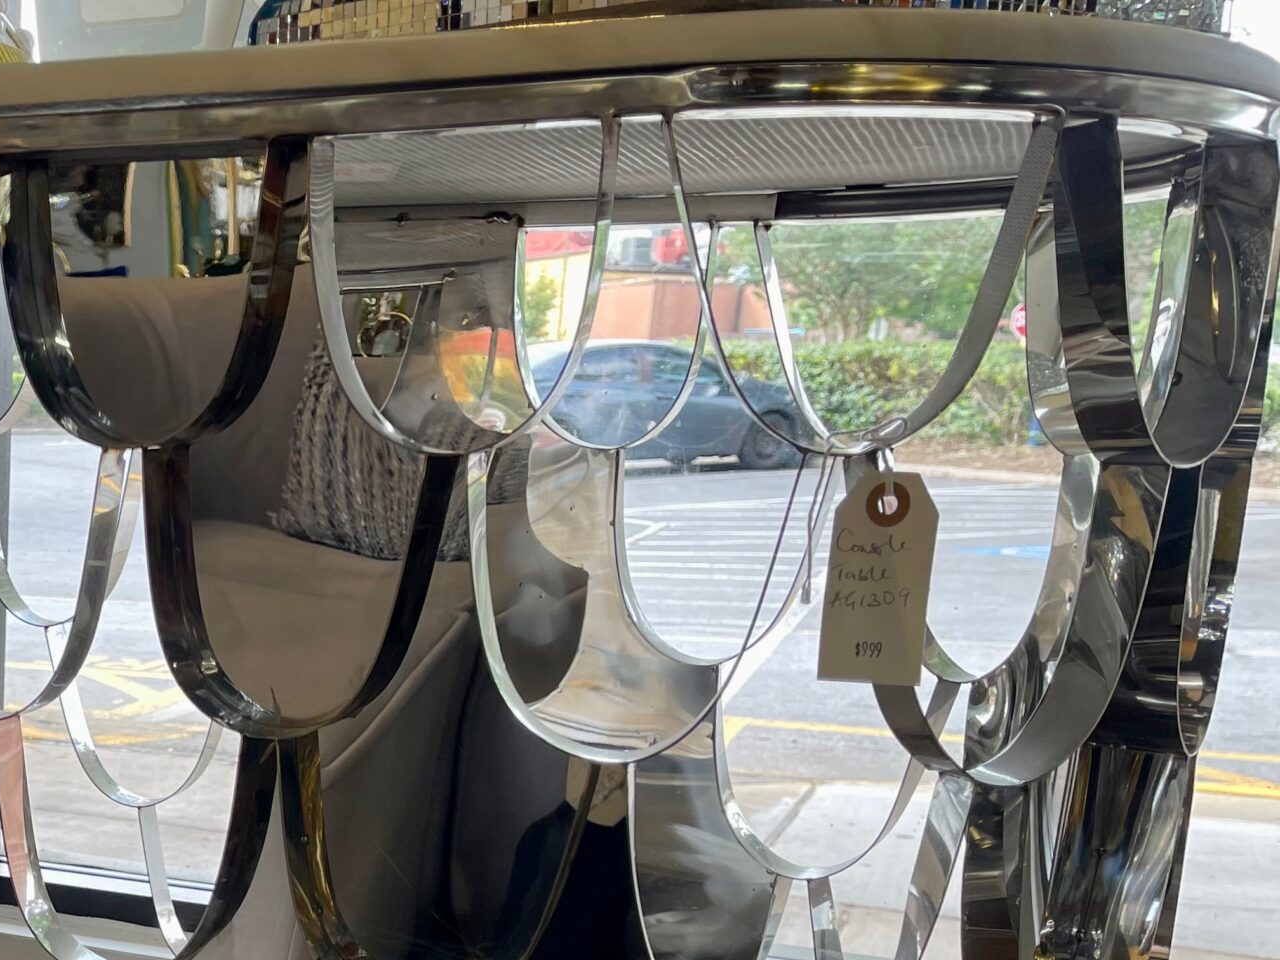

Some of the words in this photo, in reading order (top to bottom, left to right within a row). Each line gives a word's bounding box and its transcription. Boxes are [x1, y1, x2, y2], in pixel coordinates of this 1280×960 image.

[836, 528, 911, 556] Console
[831, 562, 894, 582] Table
[855, 641, 882, 658] $999
